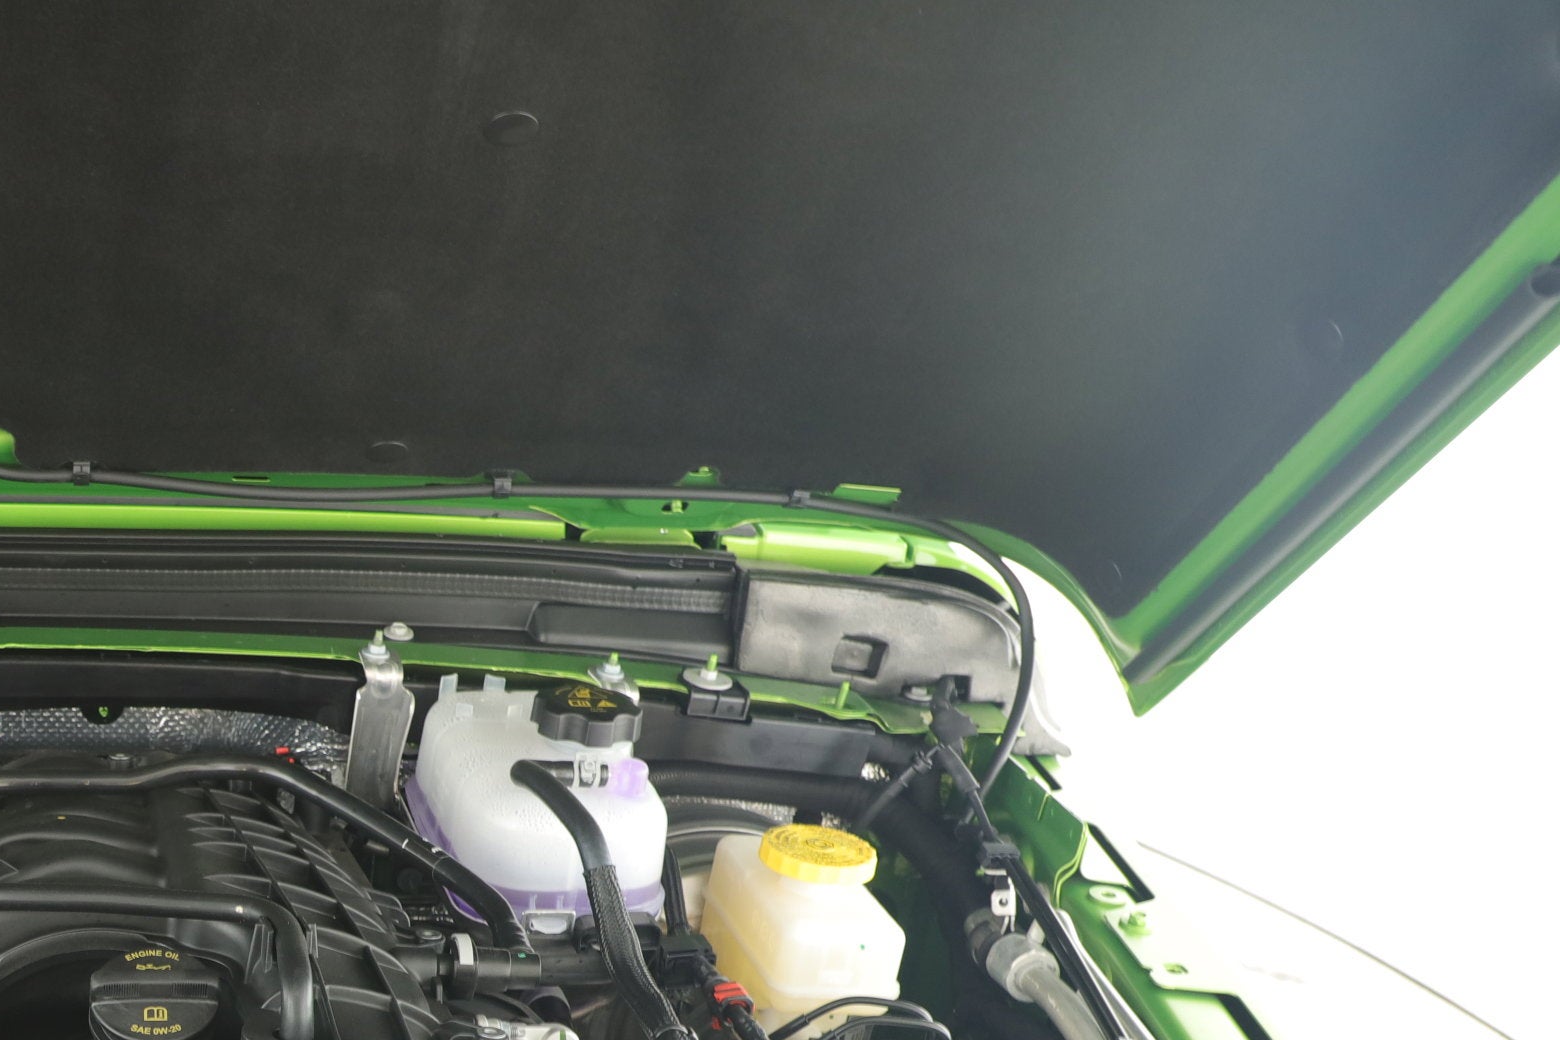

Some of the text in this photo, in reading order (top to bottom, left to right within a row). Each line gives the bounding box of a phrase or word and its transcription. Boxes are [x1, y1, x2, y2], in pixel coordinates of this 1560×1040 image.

[124, 949, 181, 962] ENGINE OIL
[130, 1024, 182, 1036] SAE 0W-20
